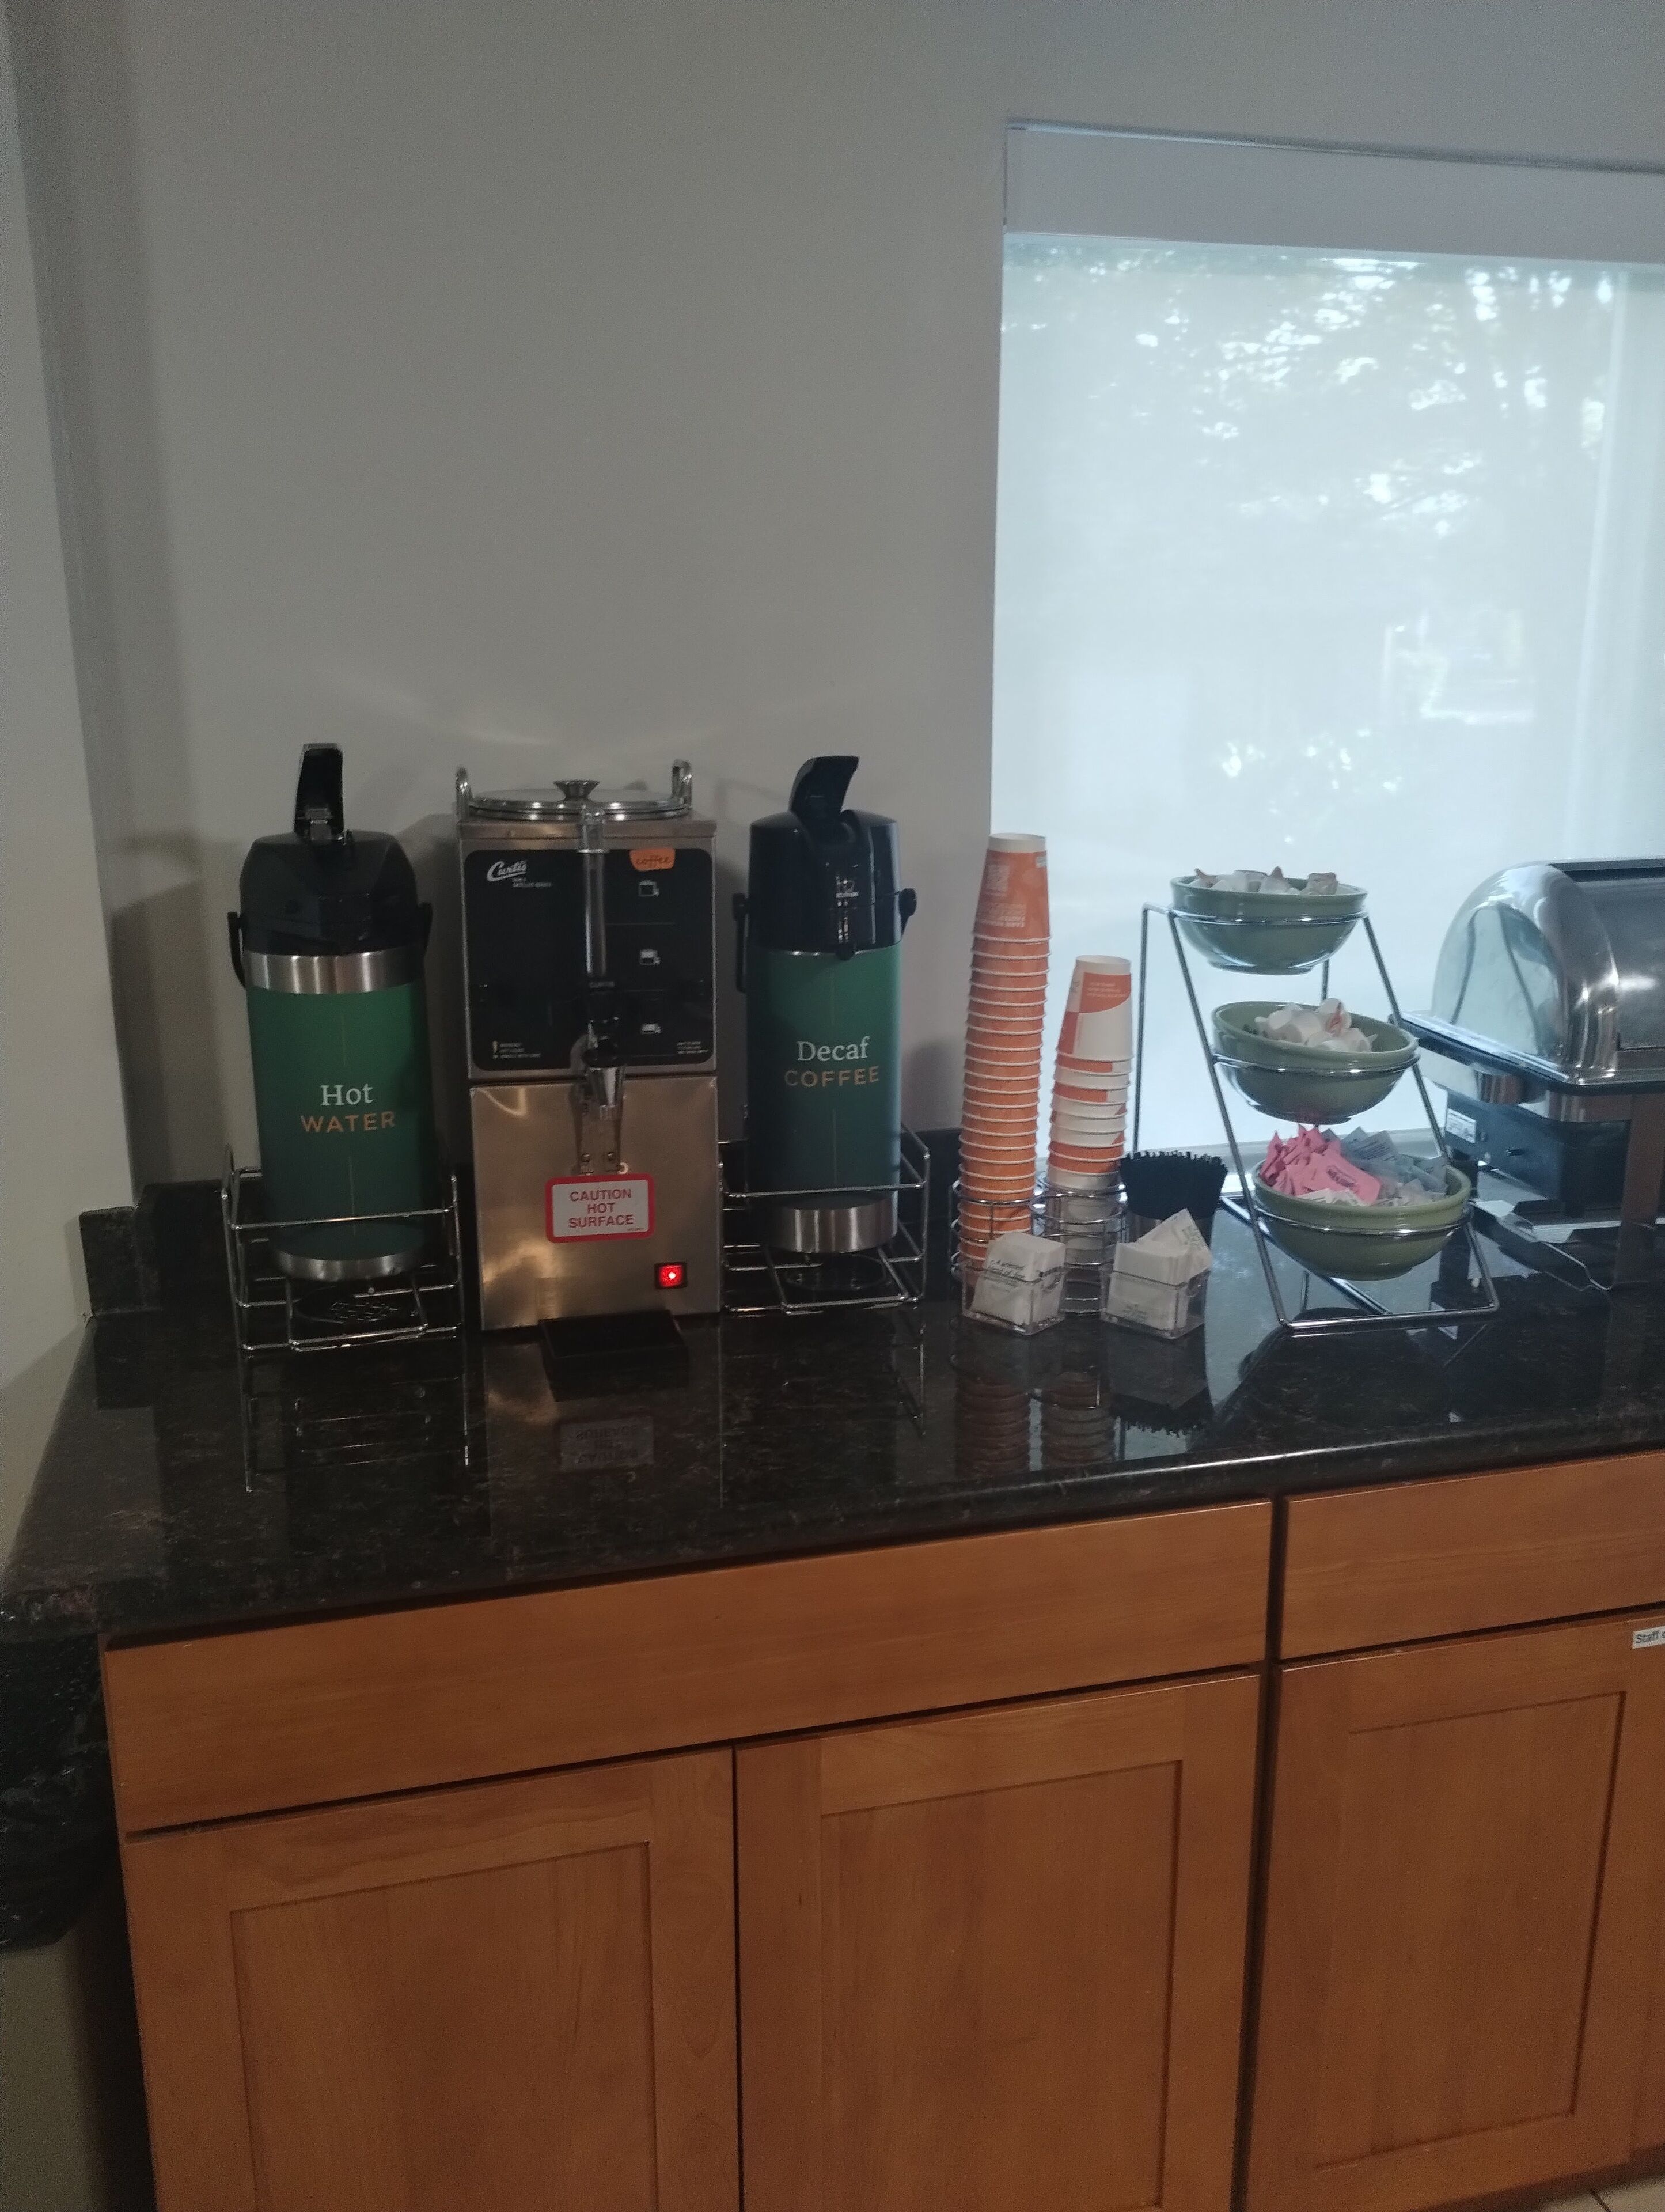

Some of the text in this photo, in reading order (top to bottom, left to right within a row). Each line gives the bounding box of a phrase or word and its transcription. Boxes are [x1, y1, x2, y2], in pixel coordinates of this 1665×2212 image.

[796, 1036, 871, 1061] Decaf
[784, 1066, 879, 1087] COFFEE
[320, 1083, 374, 1106] Hot
[301, 1111, 395, 1133] WATER
[570, 1188, 632, 1202] CAUTION
[587, 1202, 615, 1214] HOT
[568, 1214, 634, 1228] SURFACE
[1635, 1630, 1659, 1643] Staff
